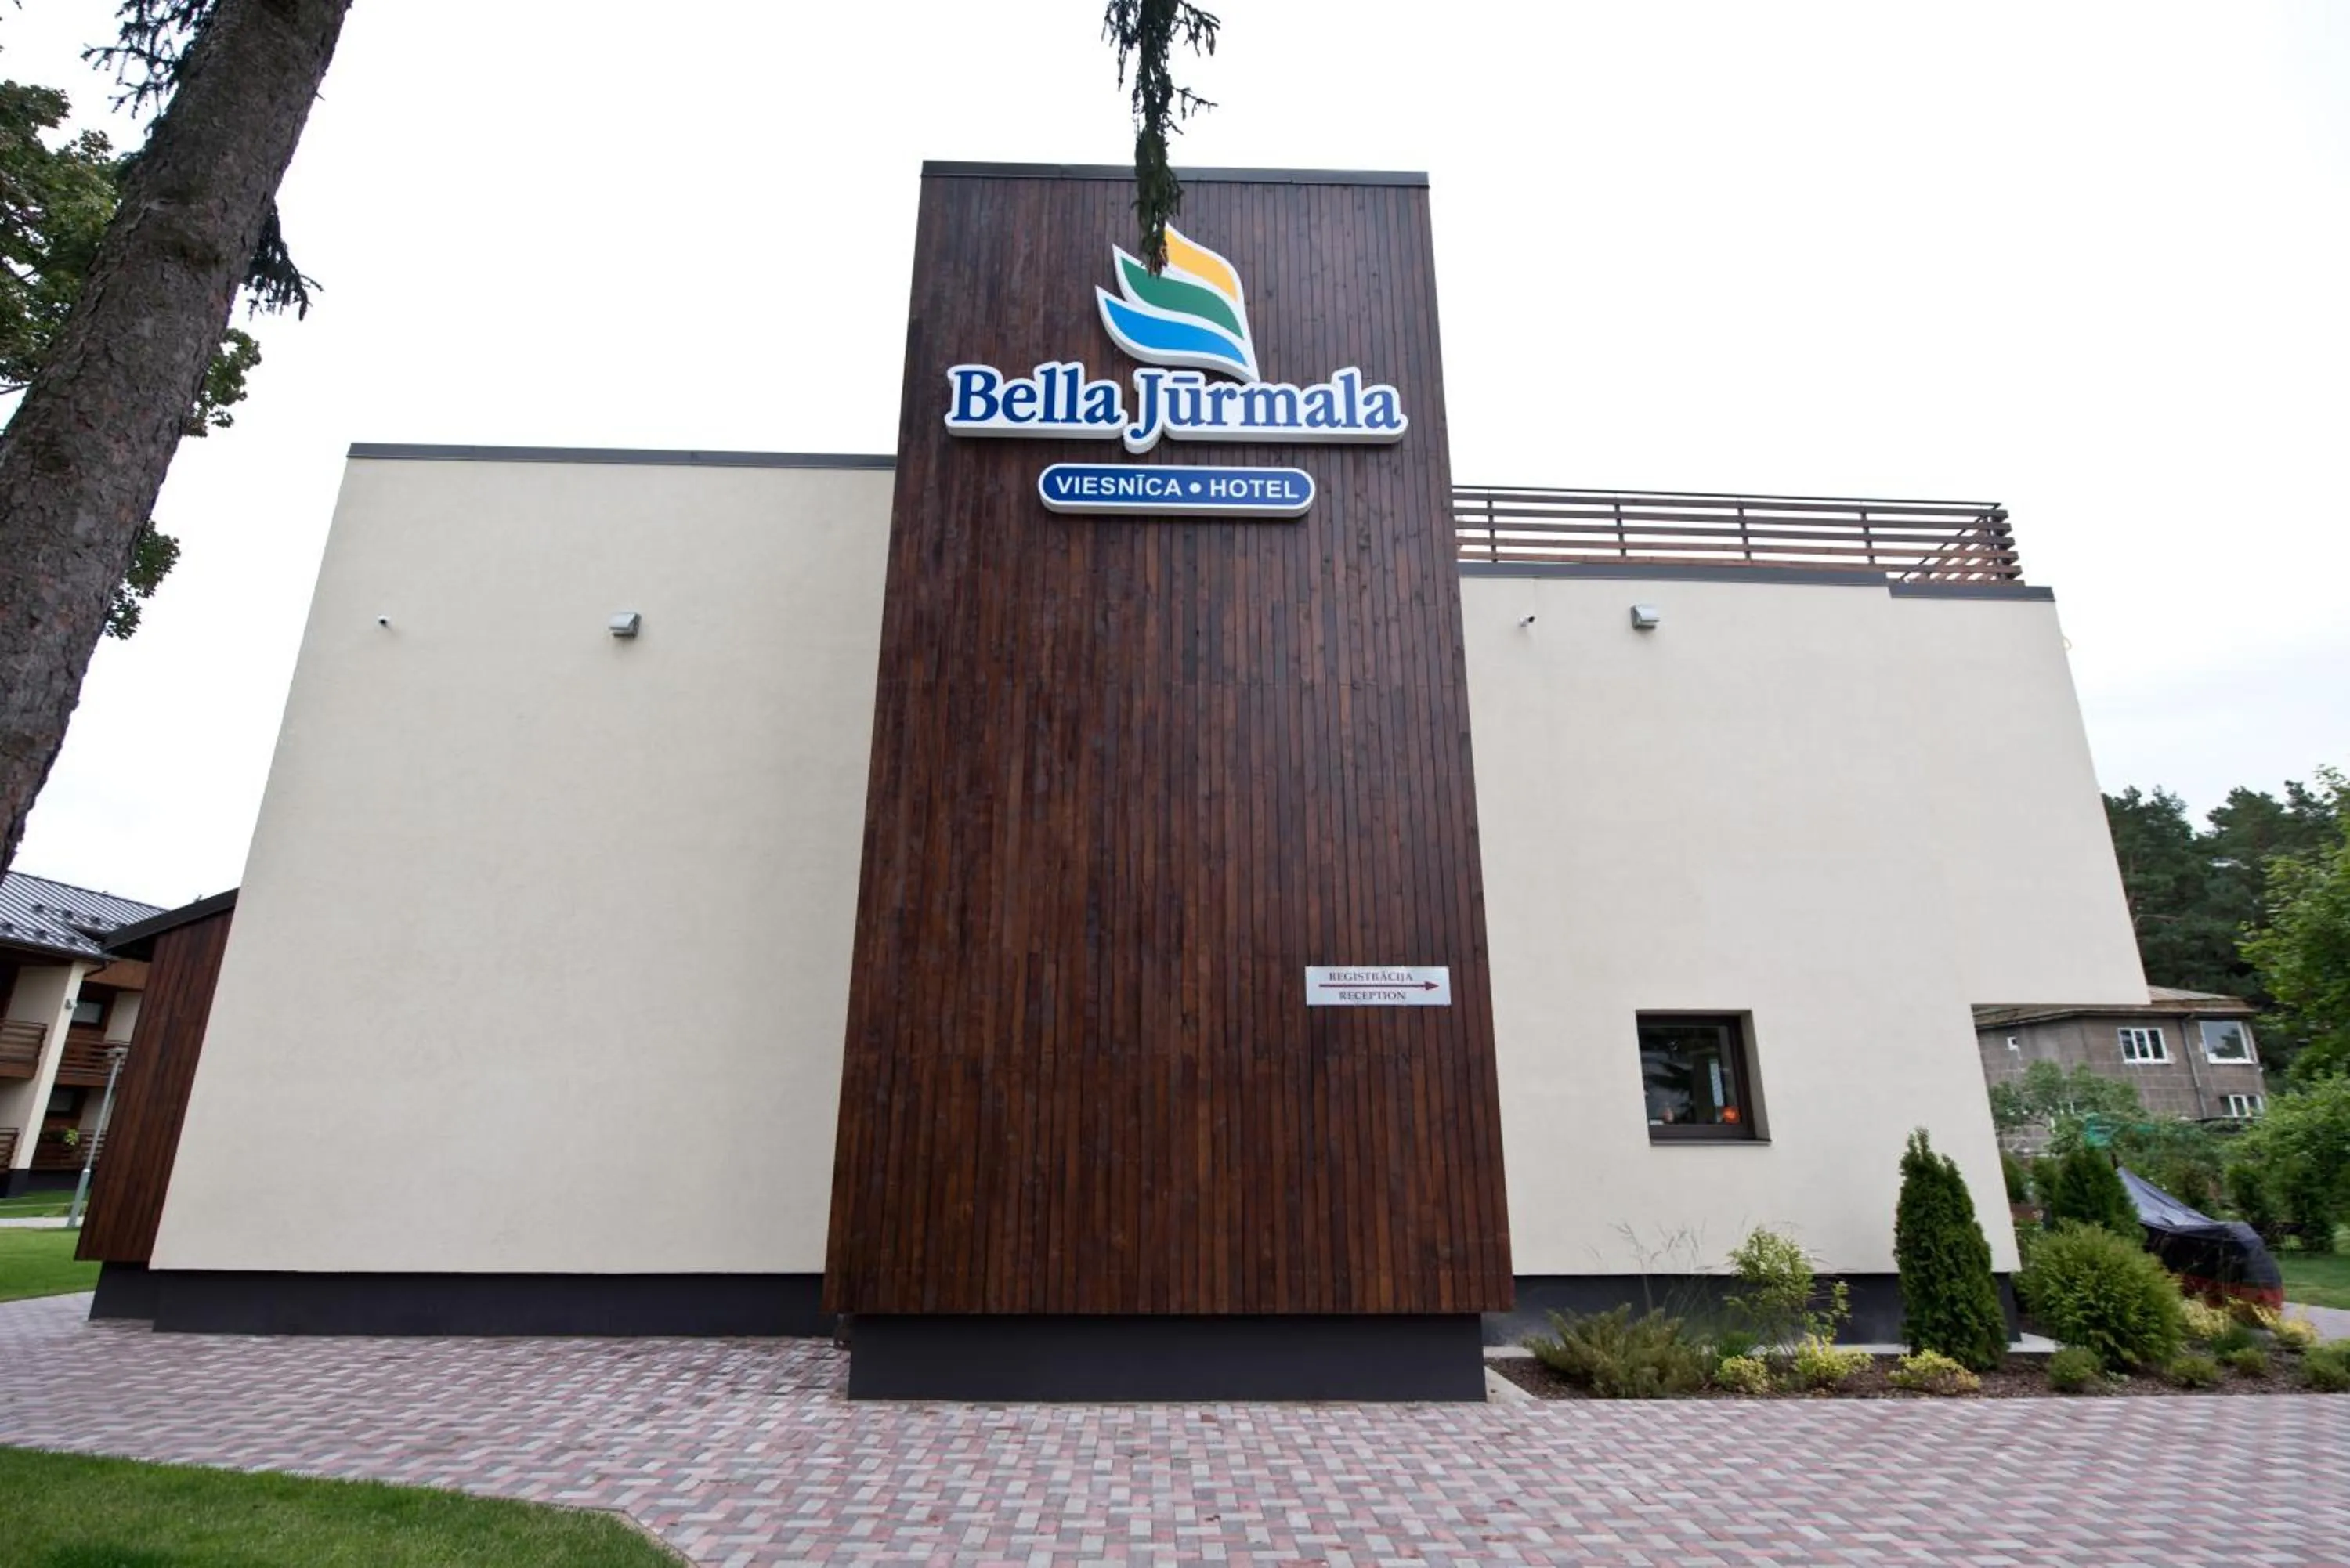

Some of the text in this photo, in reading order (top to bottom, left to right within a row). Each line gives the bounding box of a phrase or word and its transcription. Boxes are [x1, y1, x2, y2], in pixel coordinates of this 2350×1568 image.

[951, 367, 1402, 439] Bella Jūrmala
[1056, 474, 1300, 499] VIESNĪCA HOTEL
[1339, 990, 1407, 1001] RECEPTION
